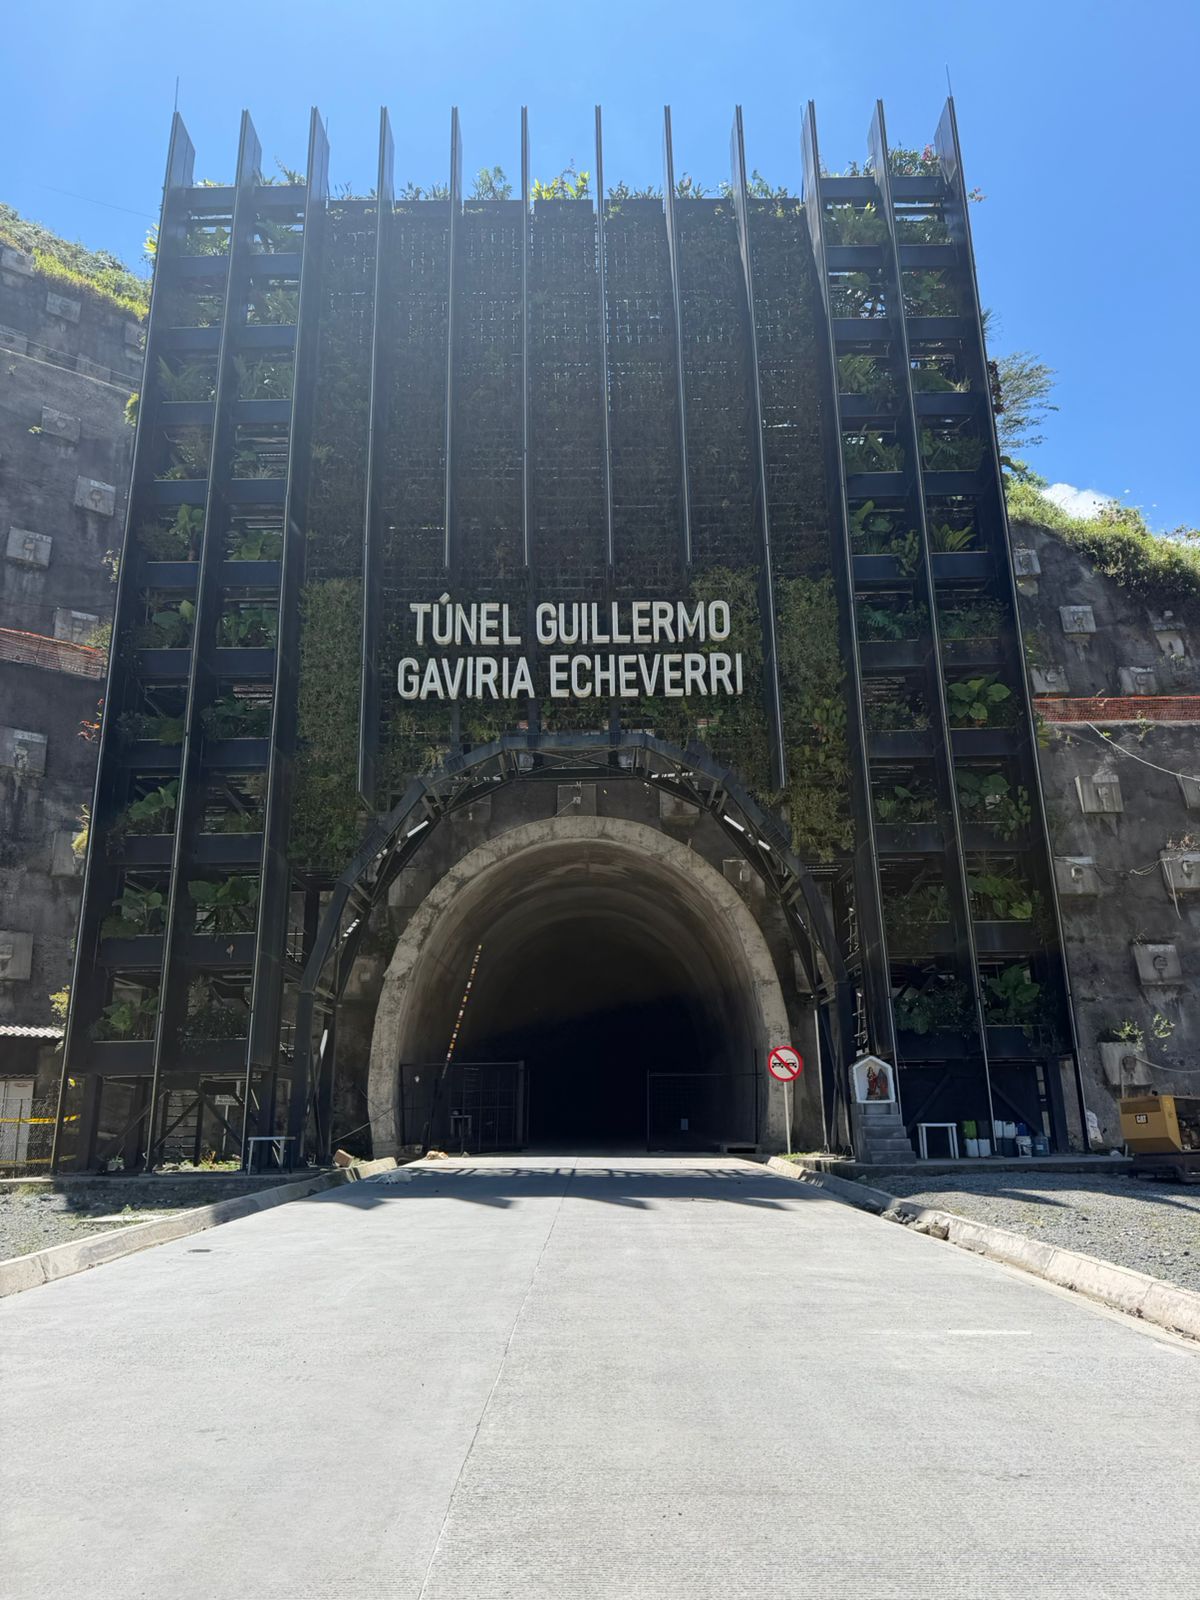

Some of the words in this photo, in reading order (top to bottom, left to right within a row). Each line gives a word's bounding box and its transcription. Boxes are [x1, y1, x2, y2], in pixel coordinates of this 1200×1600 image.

[410, 592, 521, 645] TÚNEL
[536, 600, 730, 645] GUILLERMO
[397, 656, 536, 700] GAVIRIA
[550, 653, 744, 698] ECHEVERRI
